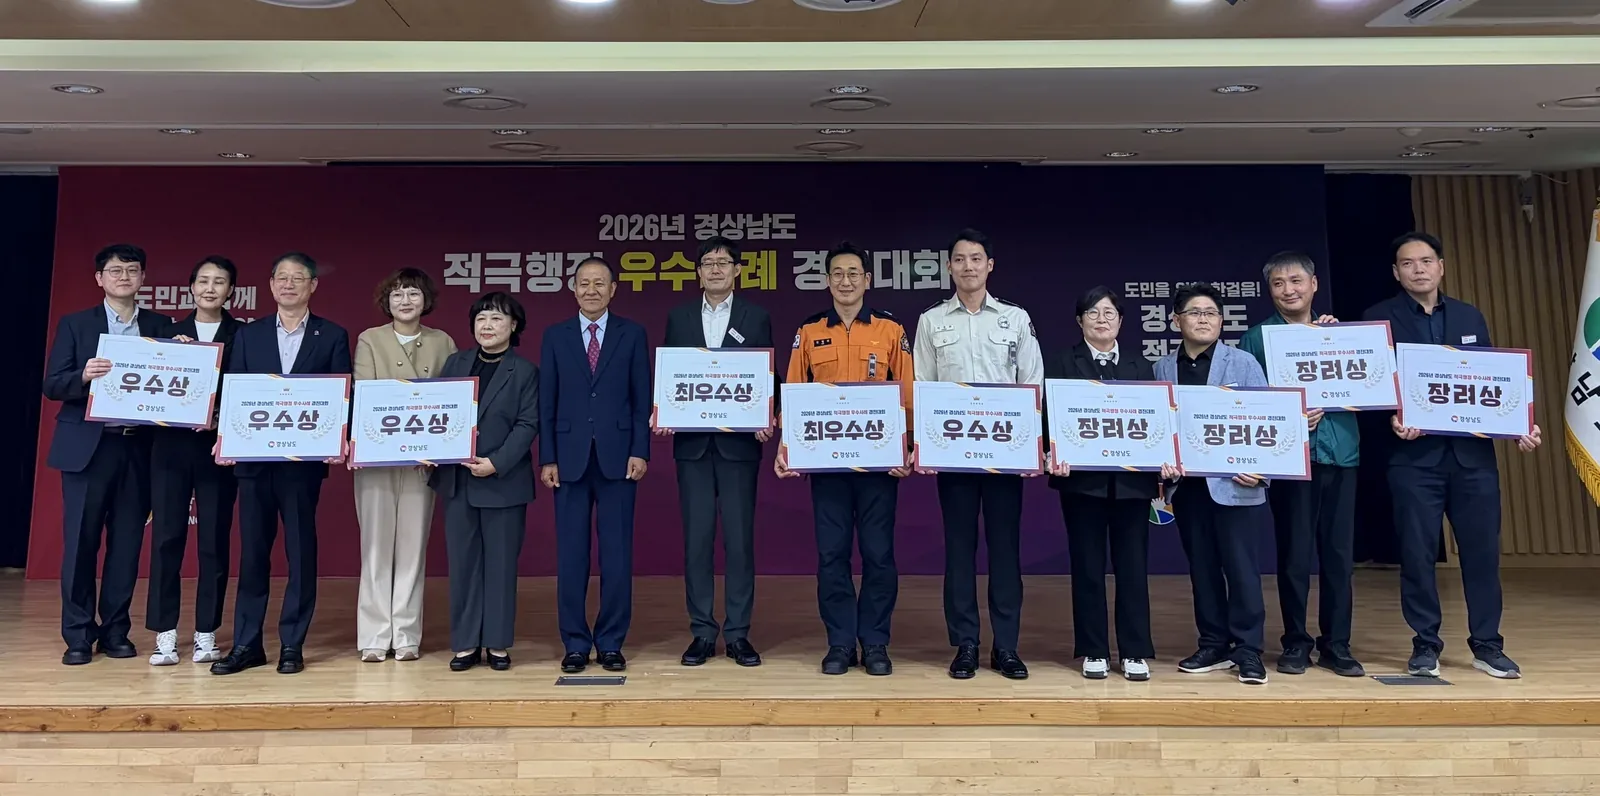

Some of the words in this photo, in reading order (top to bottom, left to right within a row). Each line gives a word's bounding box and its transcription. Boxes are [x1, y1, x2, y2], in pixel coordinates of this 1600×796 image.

[599, 213, 685, 241] 2026년
[694, 213, 796, 240] 경상남도
[619, 250, 777, 292] 우수례
[793, 249, 951, 290] 경대회
[1124, 281, 1170, 298] 도민을
[1140, 304, 1249, 332] 경도
[1295, 359, 1367, 382] 장려상
[120, 372, 190, 397] 우수상
[675, 382, 753, 403] 최우수상
[1428, 383, 1502, 407] 장려상
[248, 410, 319, 431] 우수상
[380, 413, 449, 435] 우수상
[804, 420, 885, 441] 최우수상
[943, 419, 1013, 443] 우수상
[1077, 417, 1149, 440] 장려상
[1203, 424, 1278, 447] 장려상
